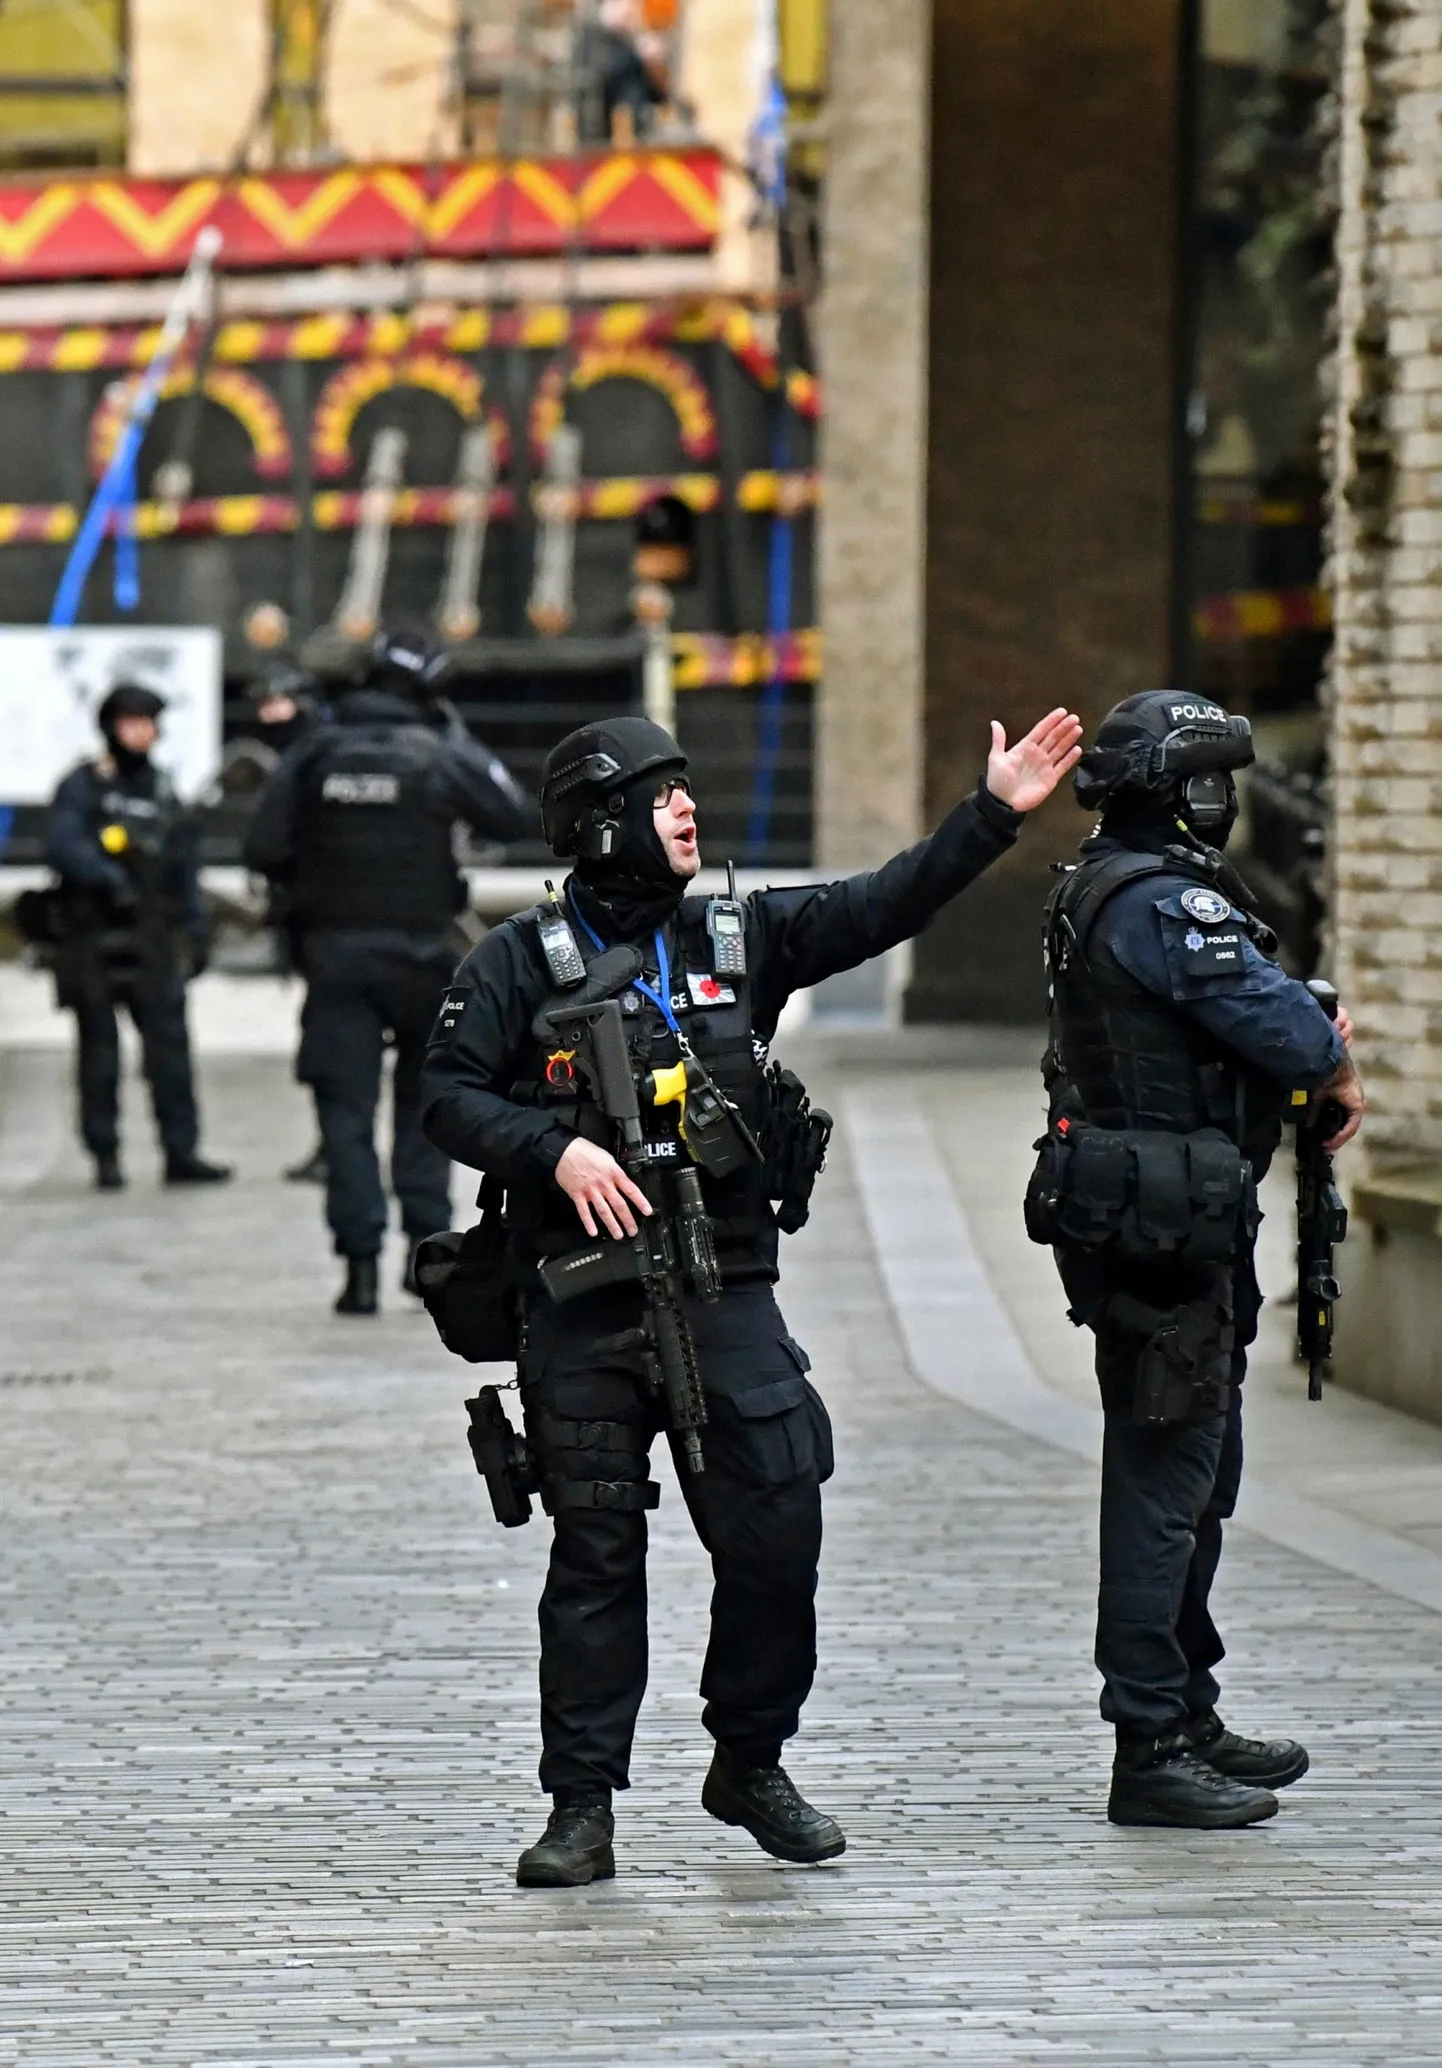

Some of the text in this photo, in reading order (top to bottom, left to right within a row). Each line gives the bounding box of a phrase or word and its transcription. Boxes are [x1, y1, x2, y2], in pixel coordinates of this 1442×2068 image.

[1170, 705, 1227, 723] POLICE
[1207, 935, 1239, 944] POLICE
[644, 1141, 677, 1158] LICE
